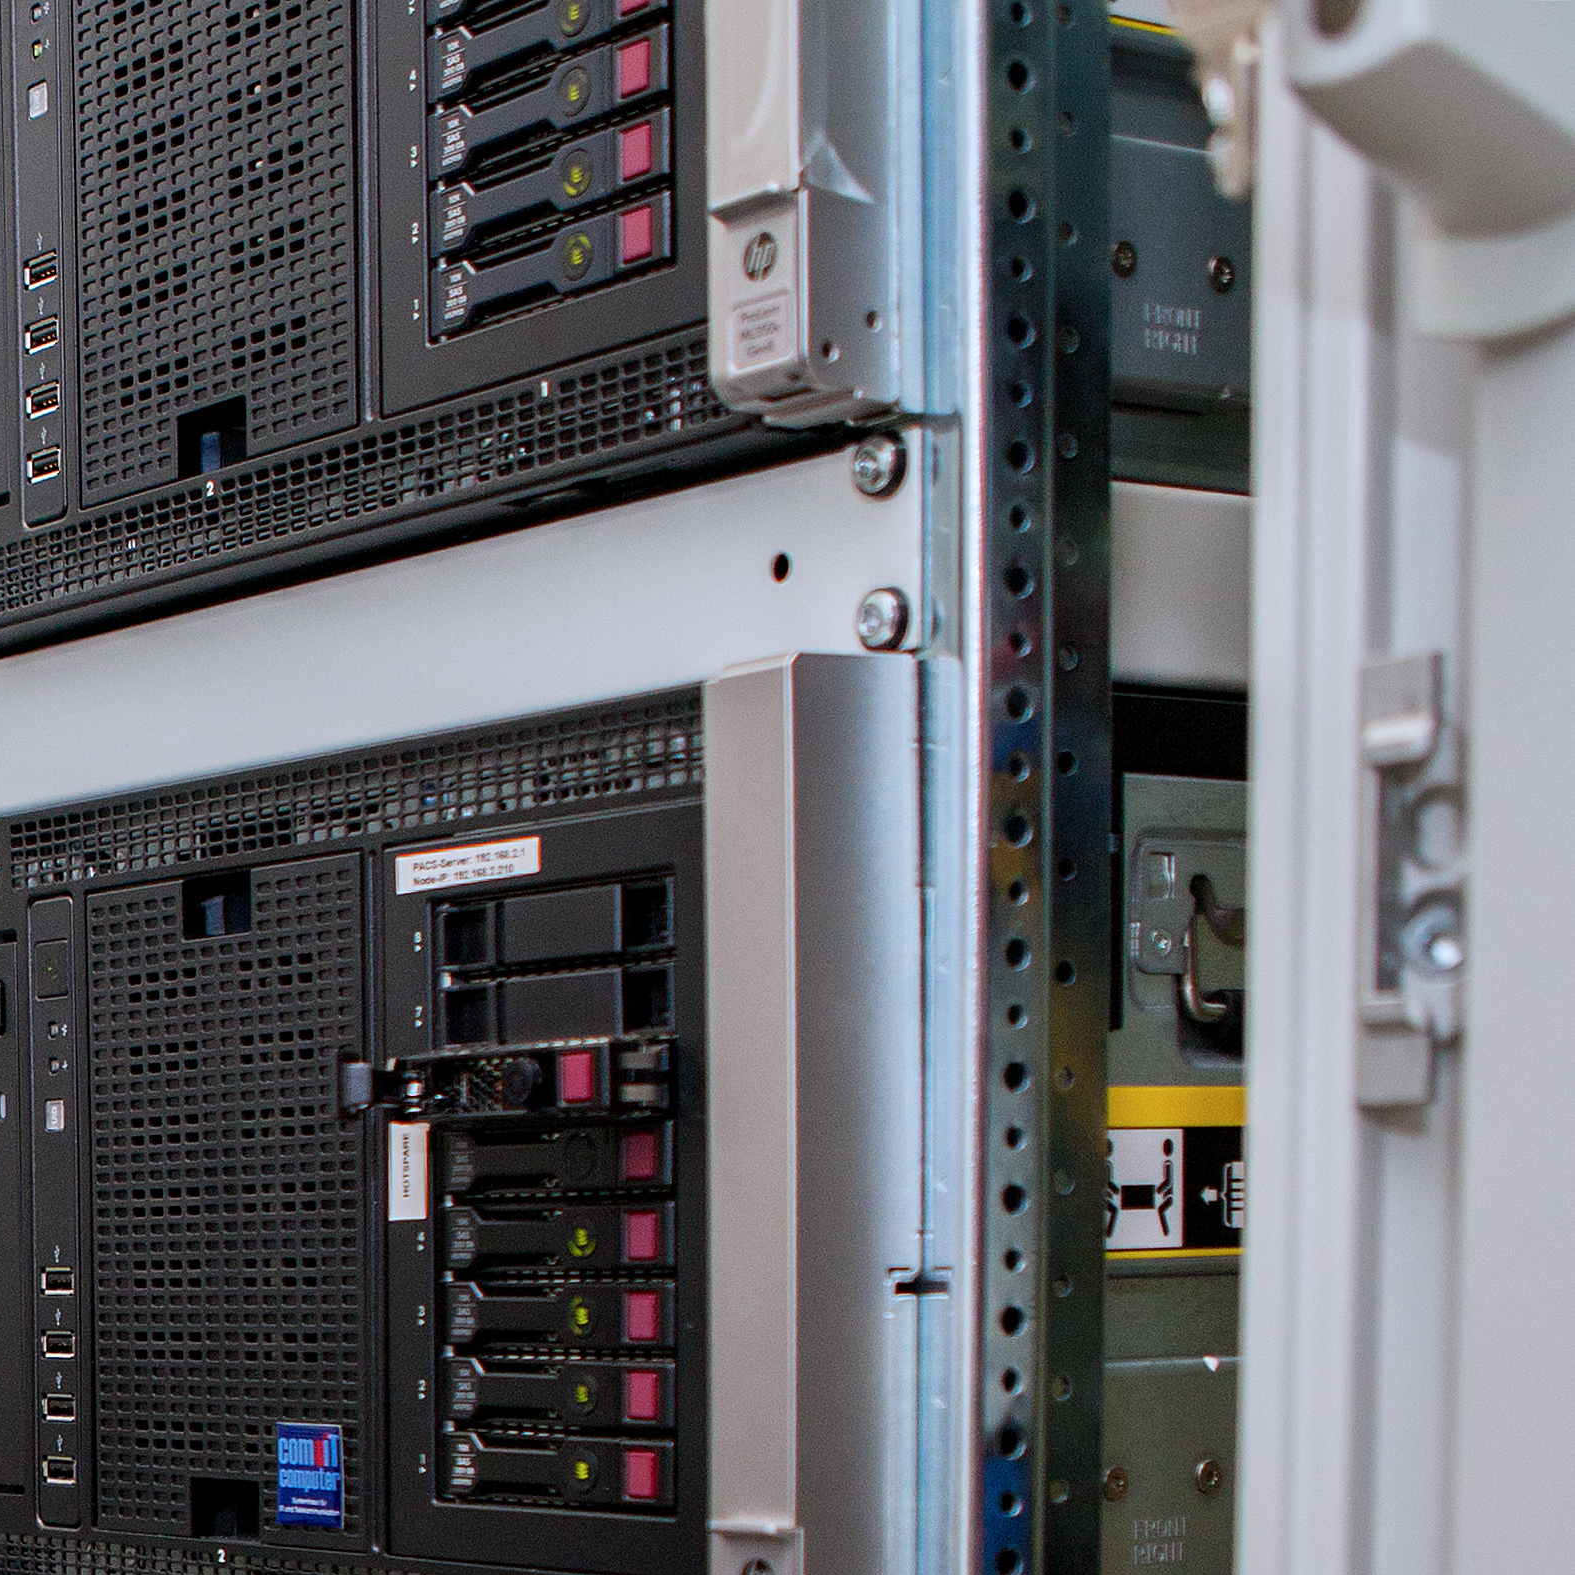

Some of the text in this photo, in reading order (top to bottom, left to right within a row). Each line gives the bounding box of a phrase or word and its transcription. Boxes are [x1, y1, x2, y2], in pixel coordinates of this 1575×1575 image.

[743, 231, 777, 281] hp
[206, 480, 215, 498] 2
[402, 1133, 411, 1198] HOTSPARE
[279, 1468, 341, 1493] computer
